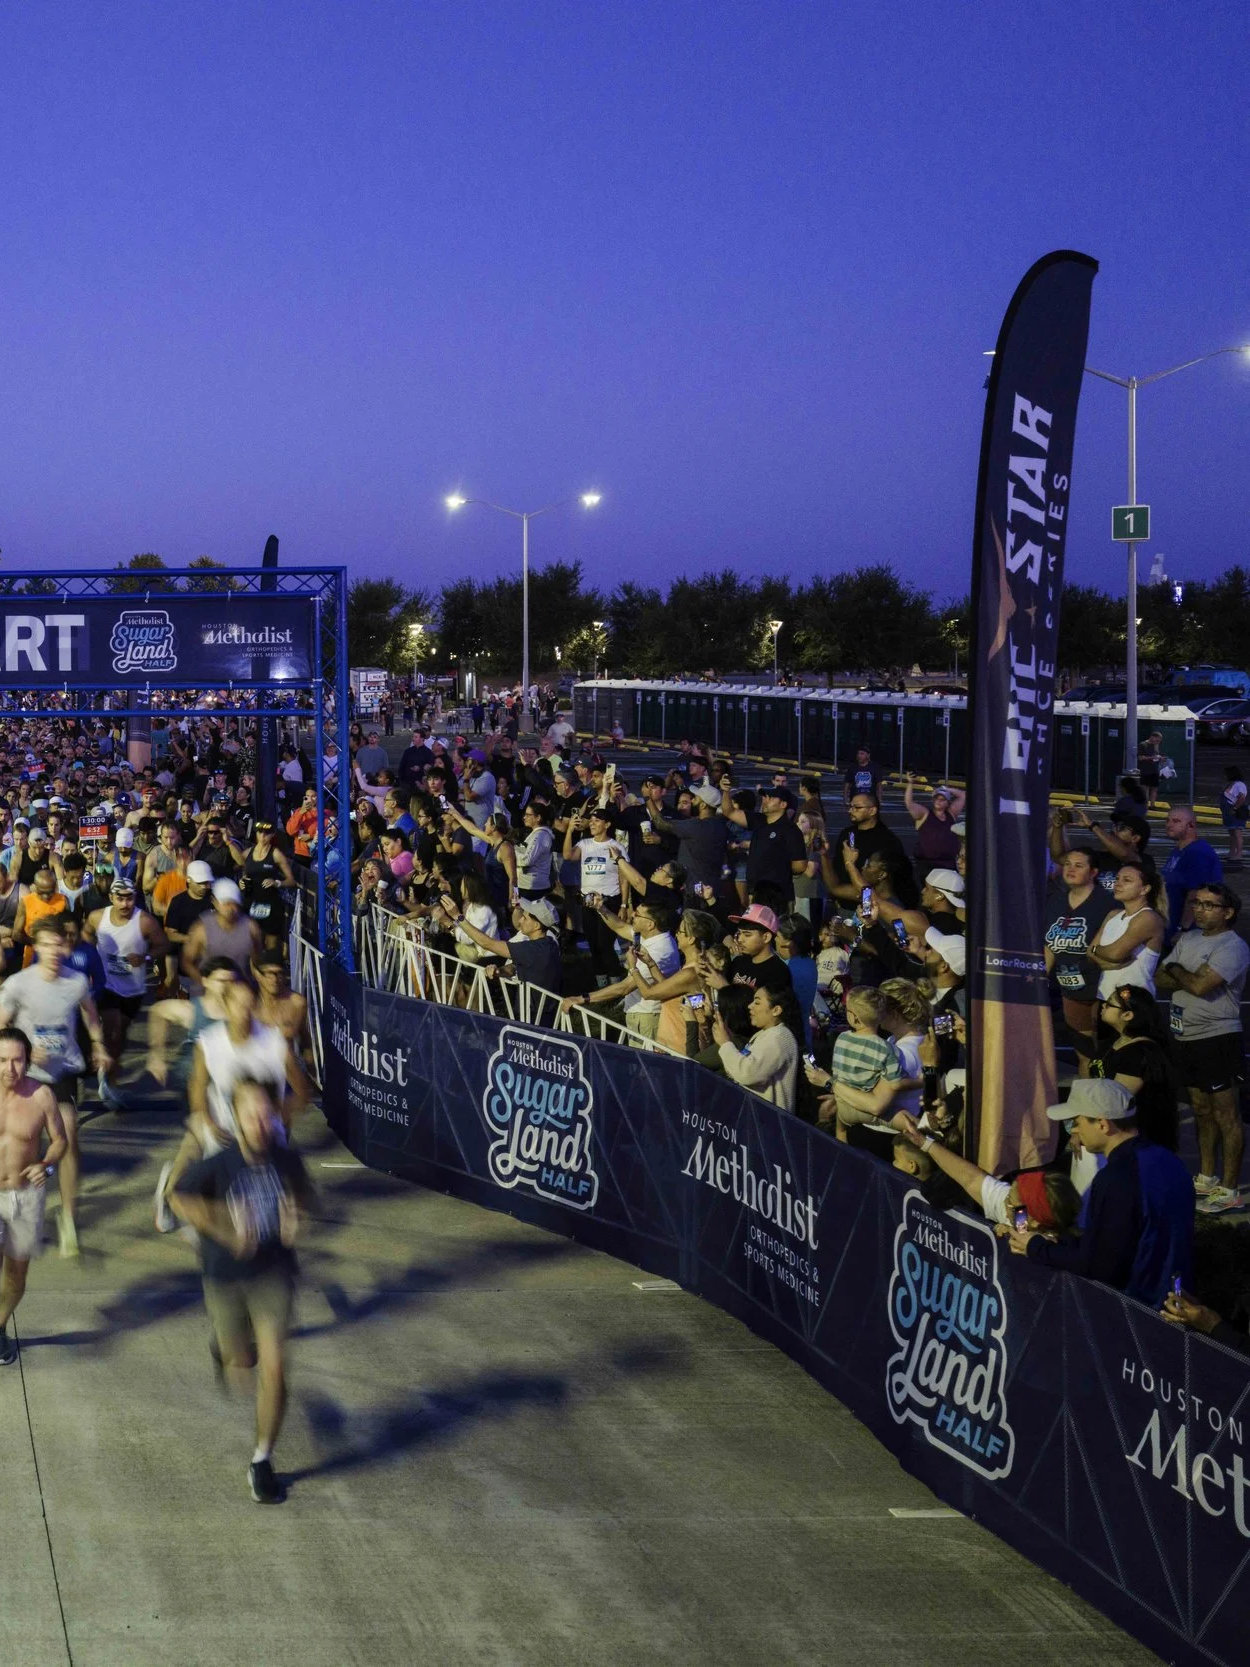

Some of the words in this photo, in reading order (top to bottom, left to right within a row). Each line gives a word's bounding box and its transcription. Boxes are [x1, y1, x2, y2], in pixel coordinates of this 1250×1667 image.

[1006, 392, 1053, 586] STAR
[1124, 512, 1134, 533] 1
[115, 625, 169, 648] Sugar
[125, 617, 164, 625] Methodist
[202, 626, 293, 645] Methodist
[117, 640, 169, 669] Land
[1051, 935, 1084, 951] Land
[331, 1019, 408, 1087] Methodist
[508, 1048, 575, 1080] Methodist
[350, 1077, 398, 1106] ORTHOPEDICS
[364, 1101, 409, 1126] MEDICINE
[491, 1062, 584, 1130] Sugar
[495, 1108, 583, 1176] Land
[681, 1109, 737, 1145] HOUSTON
[541, 1166, 591, 1197] HALF
[680, 1135, 819, 1250] Methodist
[911, 1208, 943, 1231] HOUSTON
[743, 1242, 775, 1274] SPORTS
[777, 1264, 820, 1307] MEDICINE
[750, 1225, 810, 1277] ORTHOPEDICS
[813, 1266, 819, 1283] &
[913, 1223, 988, 1281] Methodist
[895, 1241, 998, 1354] Sugar
[891, 1312, 997, 1421] Land
[1122, 1358, 1243, 1445] HOUSTON
[935, 1403, 1005, 1459] HALF
